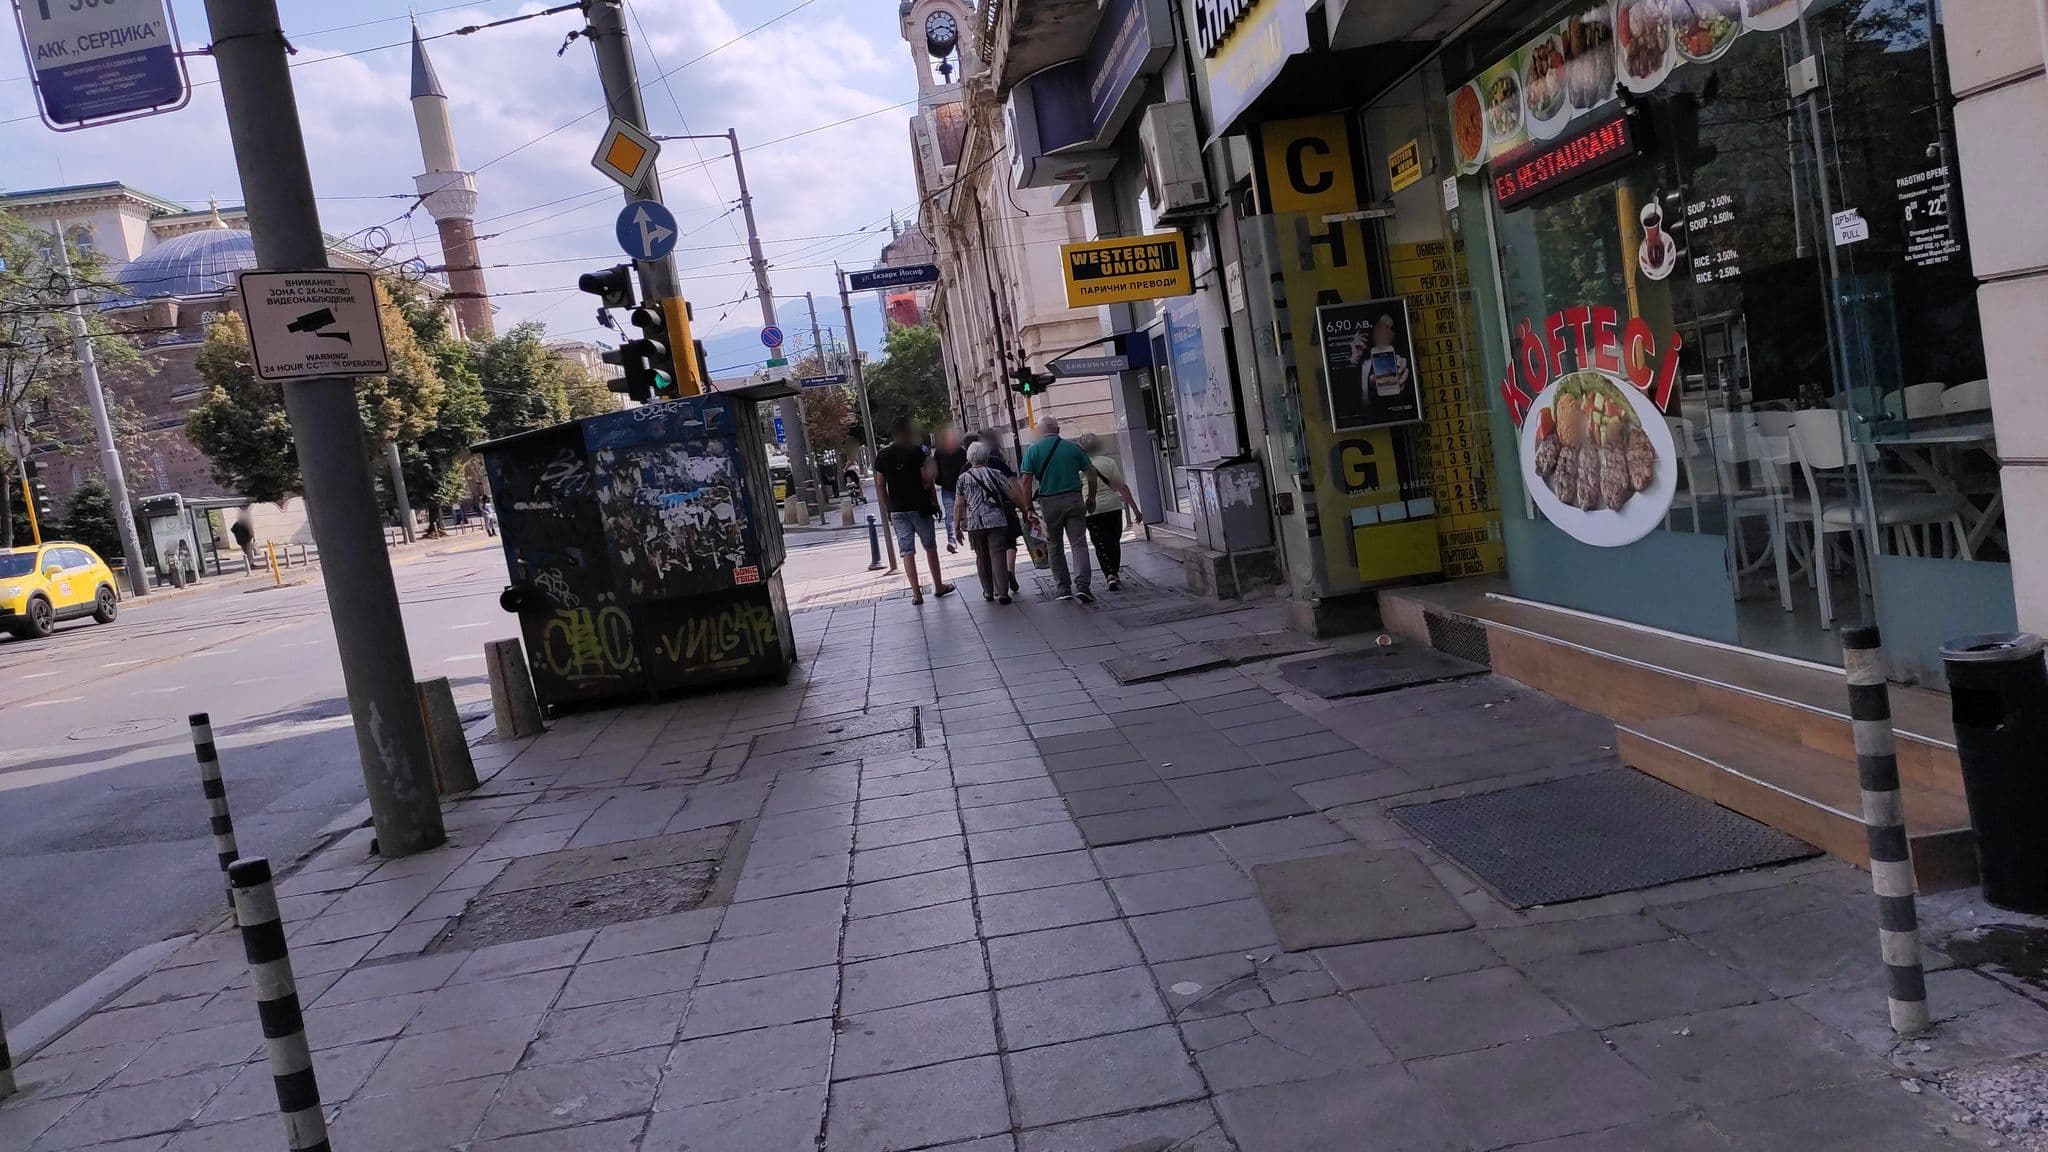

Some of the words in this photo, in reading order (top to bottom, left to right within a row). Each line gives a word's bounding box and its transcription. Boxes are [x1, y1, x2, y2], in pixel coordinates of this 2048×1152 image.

[37, 40, 68, 60] АКК
[1516, 118, 1627, 191] RESTAURANT
[1896, 173, 1926, 188] РАБОТНО
[1926, 166, 1950, 180] ВРЕМЕ
[1687, 201, 1706, 216] SOUP
[1689, 217, 1708, 232] SOUP
[1842, 229, 1861, 241] PULL
[1071, 245, 1160, 266] WESTERN
[1694, 255, 1710, 268] RICE
[899, 267, 924, 278] Йосиф
[1101, 257, 1161, 275] UNION
[285, 279, 336, 287] ВНИМАНИЕ!
[1696, 271, 1713, 284] RICE
[269, 288, 296, 297] ЗОНА
[307, 287, 351, 295] 24-ЧАСОВО
[1080, 284, 1127, 295] ПАРИЧНИ
[1129, 278, 1177, 290] ПРЕВОДИ
[266, 296, 356, 305] ВИДЕОНАБЛЮДЕНИЕ
[1326, 320, 1351, 333] 6,90
[306, 352, 349, 361] WARNING!
[277, 364, 304, 372] HOUR
[342, 359, 383, 368] OPERATION
